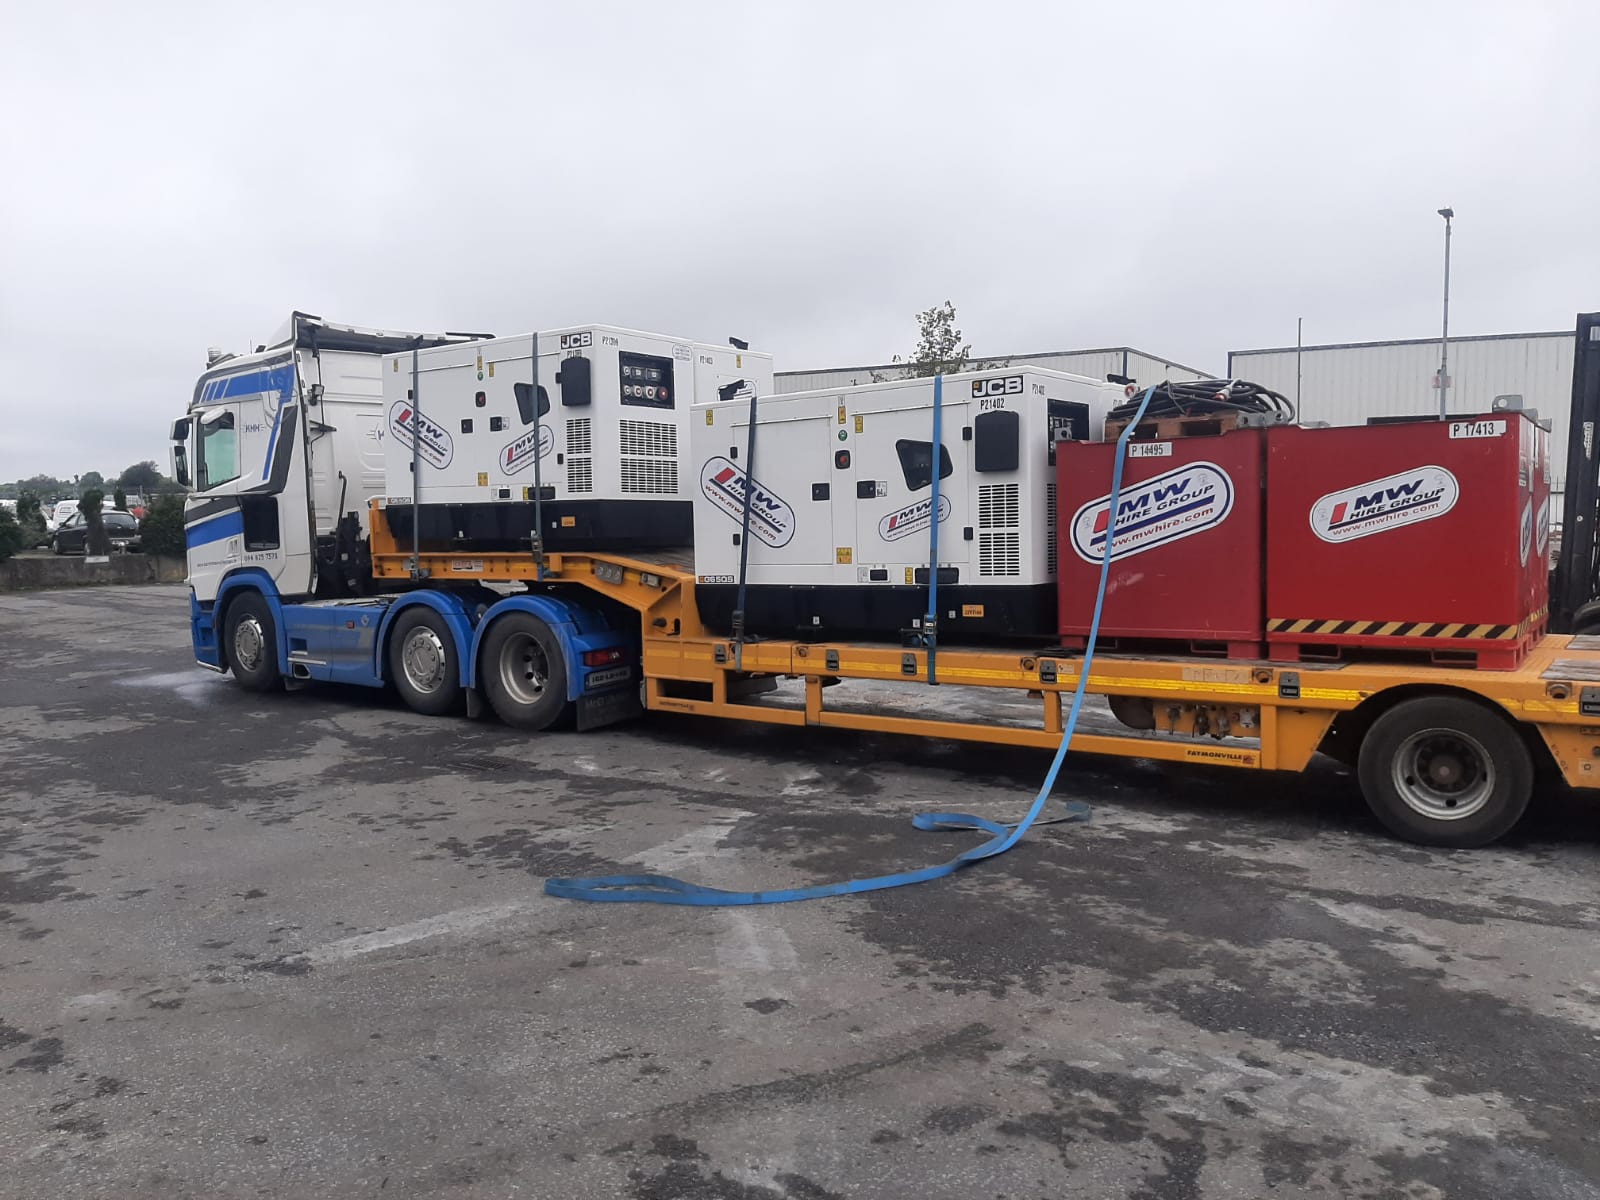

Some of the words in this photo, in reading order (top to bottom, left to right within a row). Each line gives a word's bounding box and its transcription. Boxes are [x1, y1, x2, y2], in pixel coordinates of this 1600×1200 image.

[561, 332, 592, 349] JCB
[972, 376, 1023, 398] JCB
[980, 398, 1005, 410] P21402
[423, 434, 448, 452] GROUP
[1454, 424, 1460, 437] P
[1464, 422, 1494, 436] 17413
[1131, 446, 1137, 456] P
[1140, 445, 1163, 456] 14495
[727, 484, 747, 502] HIR
[752, 502, 787, 528] GROUP
[733, 476, 782, 511] MW
[1115, 507, 1151, 526] HIRE
[1157, 484, 1214, 511] GROUP
[1117, 478, 1191, 516] MW
[1350, 503, 1386, 520] HIRE
[1390, 487, 1446, 509] GROUP
[1354, 479, 1424, 511] MW
[899, 500, 935, 520] MW
[1333, 502, 1440, 536] www.mwhire.com
